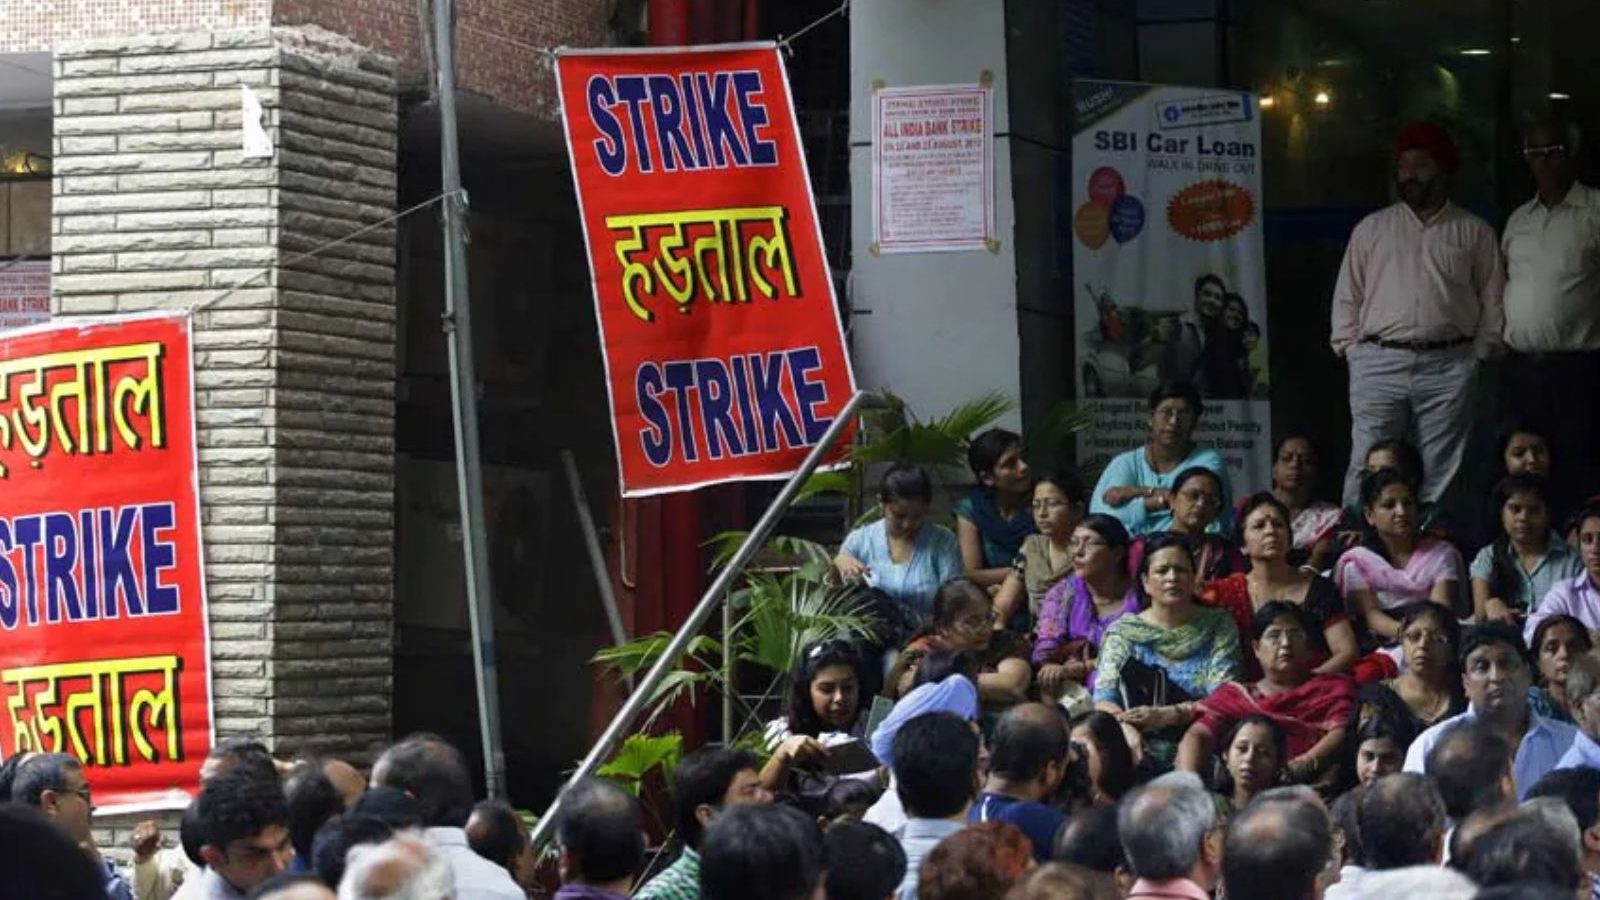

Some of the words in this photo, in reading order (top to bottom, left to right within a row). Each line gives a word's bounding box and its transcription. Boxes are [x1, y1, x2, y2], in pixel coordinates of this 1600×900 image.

[587, 70, 779, 176] STRIKE
[883, 121, 899, 138] ALL
[900, 120, 923, 137] INDIA
[924, 120, 948, 136] BANK
[951, 118, 983, 134] STRIKE
[1094, 130, 1137, 151] SBI
[1146, 132, 1189, 154] Car
[1197, 135, 1256, 158] Loan
[1147, 159, 1178, 171] WALK
[1198, 161, 1231, 173] DRIVE
[1233, 162, 1256, 175] OUT
[605, 207, 801, 322] हड़ताल
[635, 346, 836, 467] STRIKE
[0, 501, 181, 631] STRIKE
